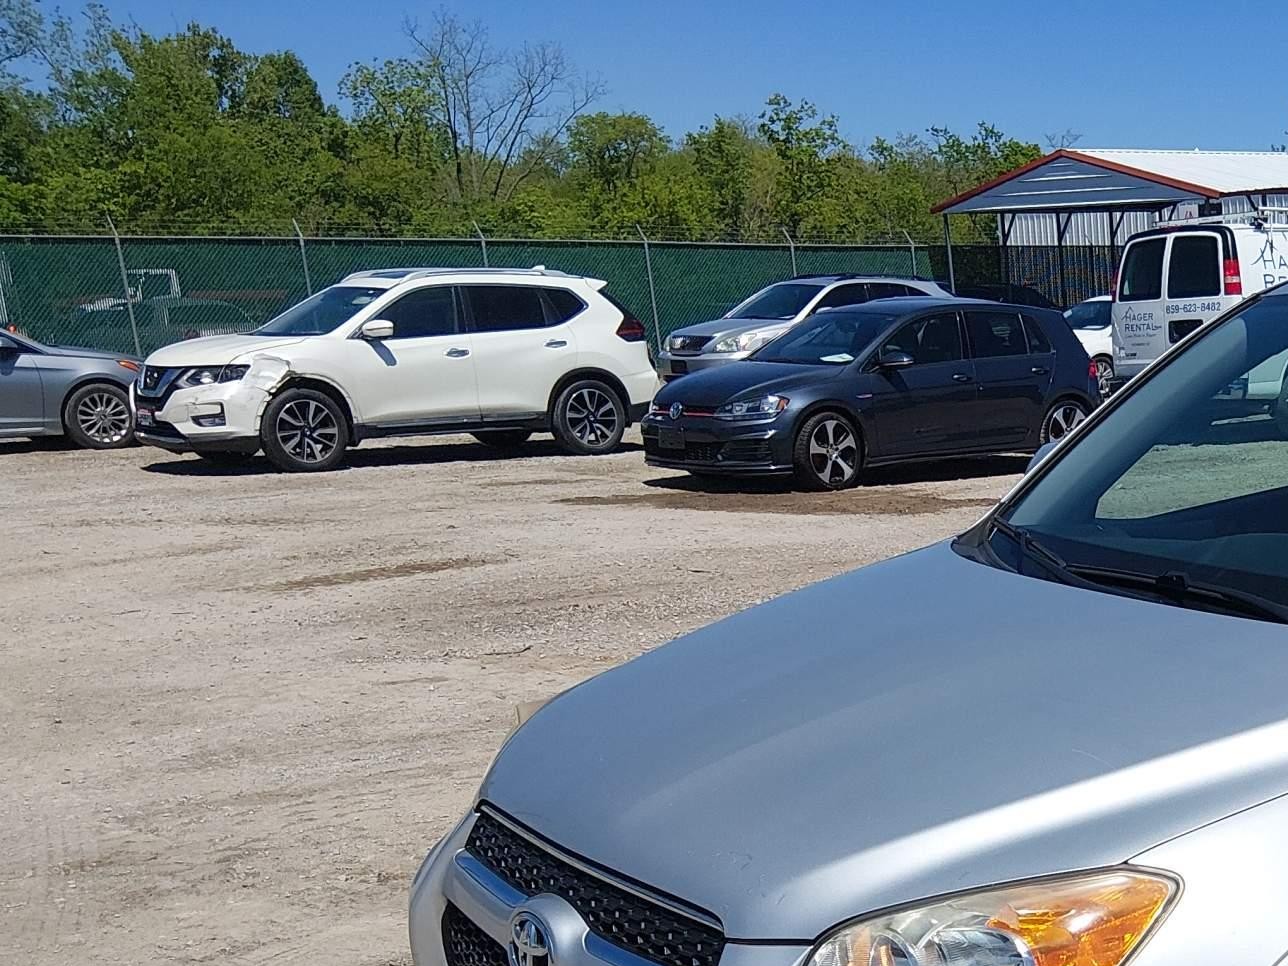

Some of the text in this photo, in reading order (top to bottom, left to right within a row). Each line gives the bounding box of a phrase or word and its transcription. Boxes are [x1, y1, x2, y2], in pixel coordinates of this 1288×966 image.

[1165, 301, 1221, 314] 859-623-8482
[1125, 312, 1154, 322] HAGER
[1125, 323, 1155, 332] RENTAL
